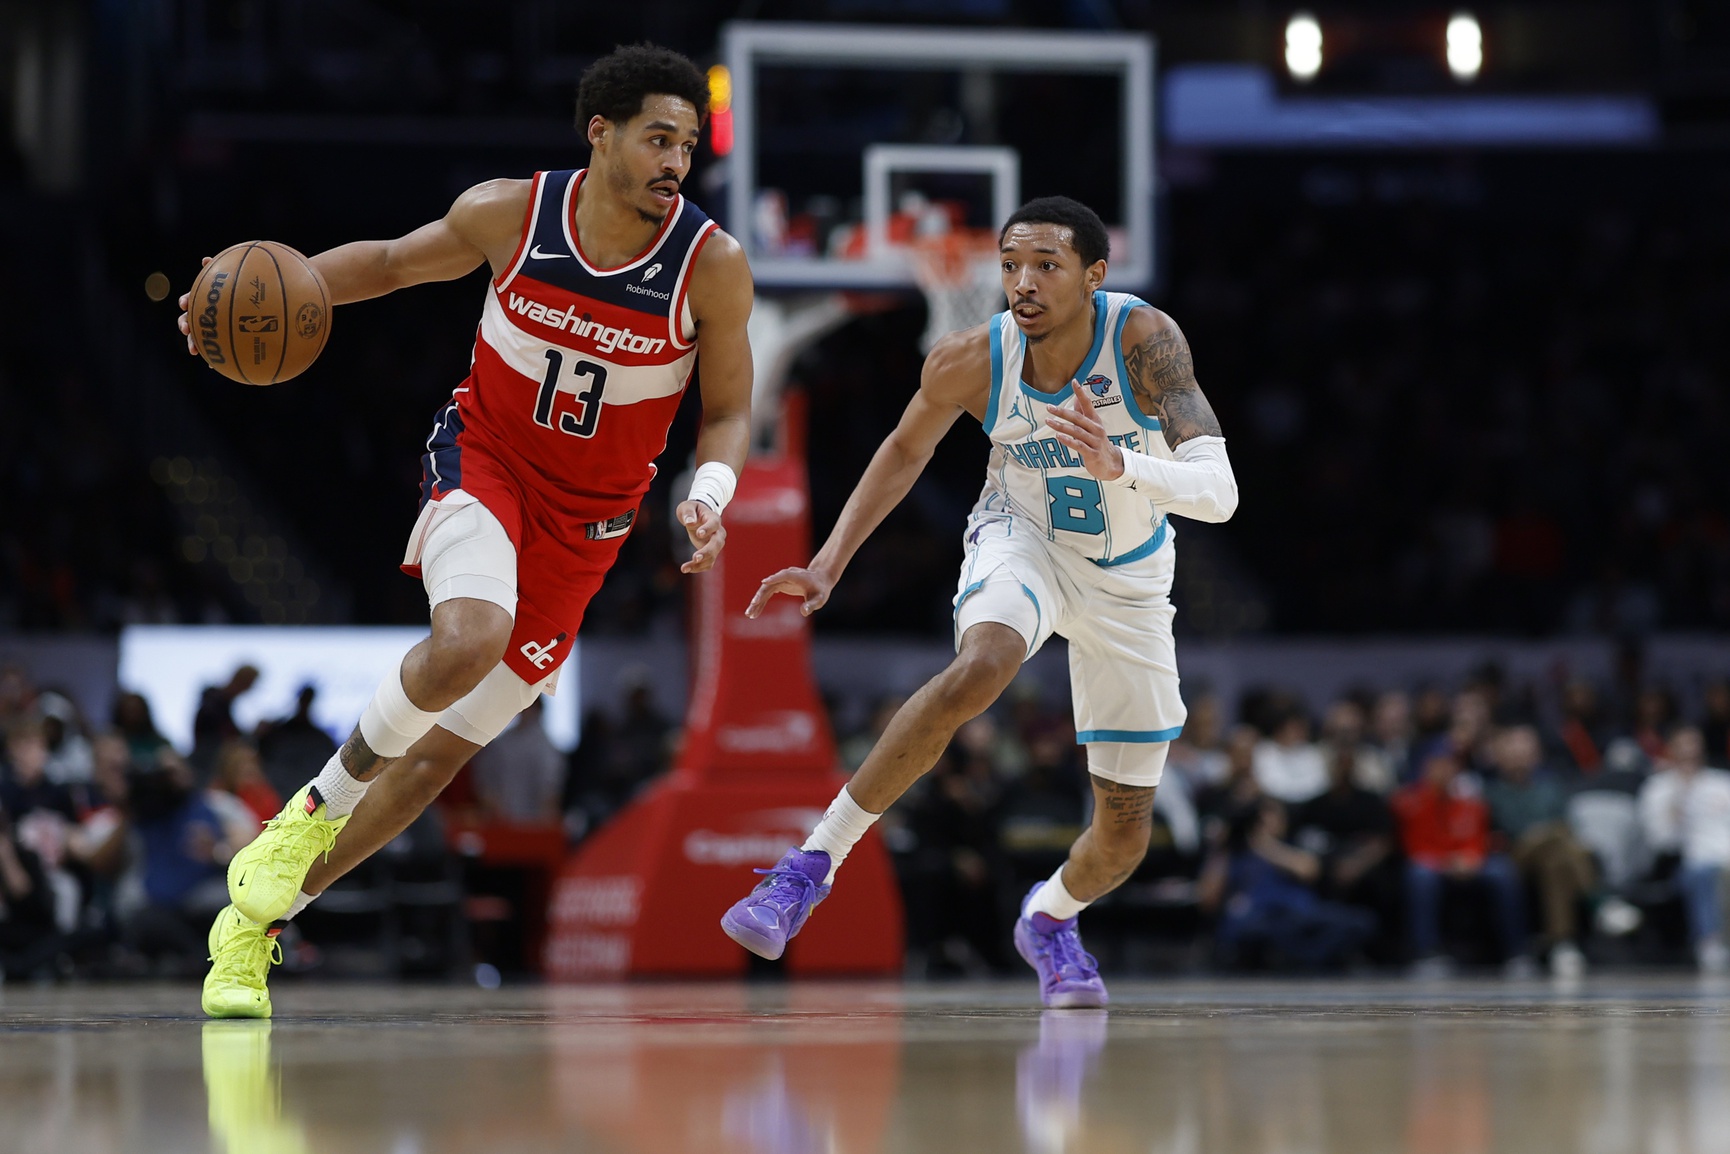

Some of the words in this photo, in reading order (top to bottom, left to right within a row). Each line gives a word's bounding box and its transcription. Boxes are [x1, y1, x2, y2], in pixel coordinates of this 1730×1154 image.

[199, 272, 229, 364] Wilson
[626, 283, 670, 300] Robinhood
[508, 292, 667, 354] washington
[532, 347, 608, 439] 13
[1004, 431, 1142, 469] HARLTE
[1046, 475, 1106, 535] 8
